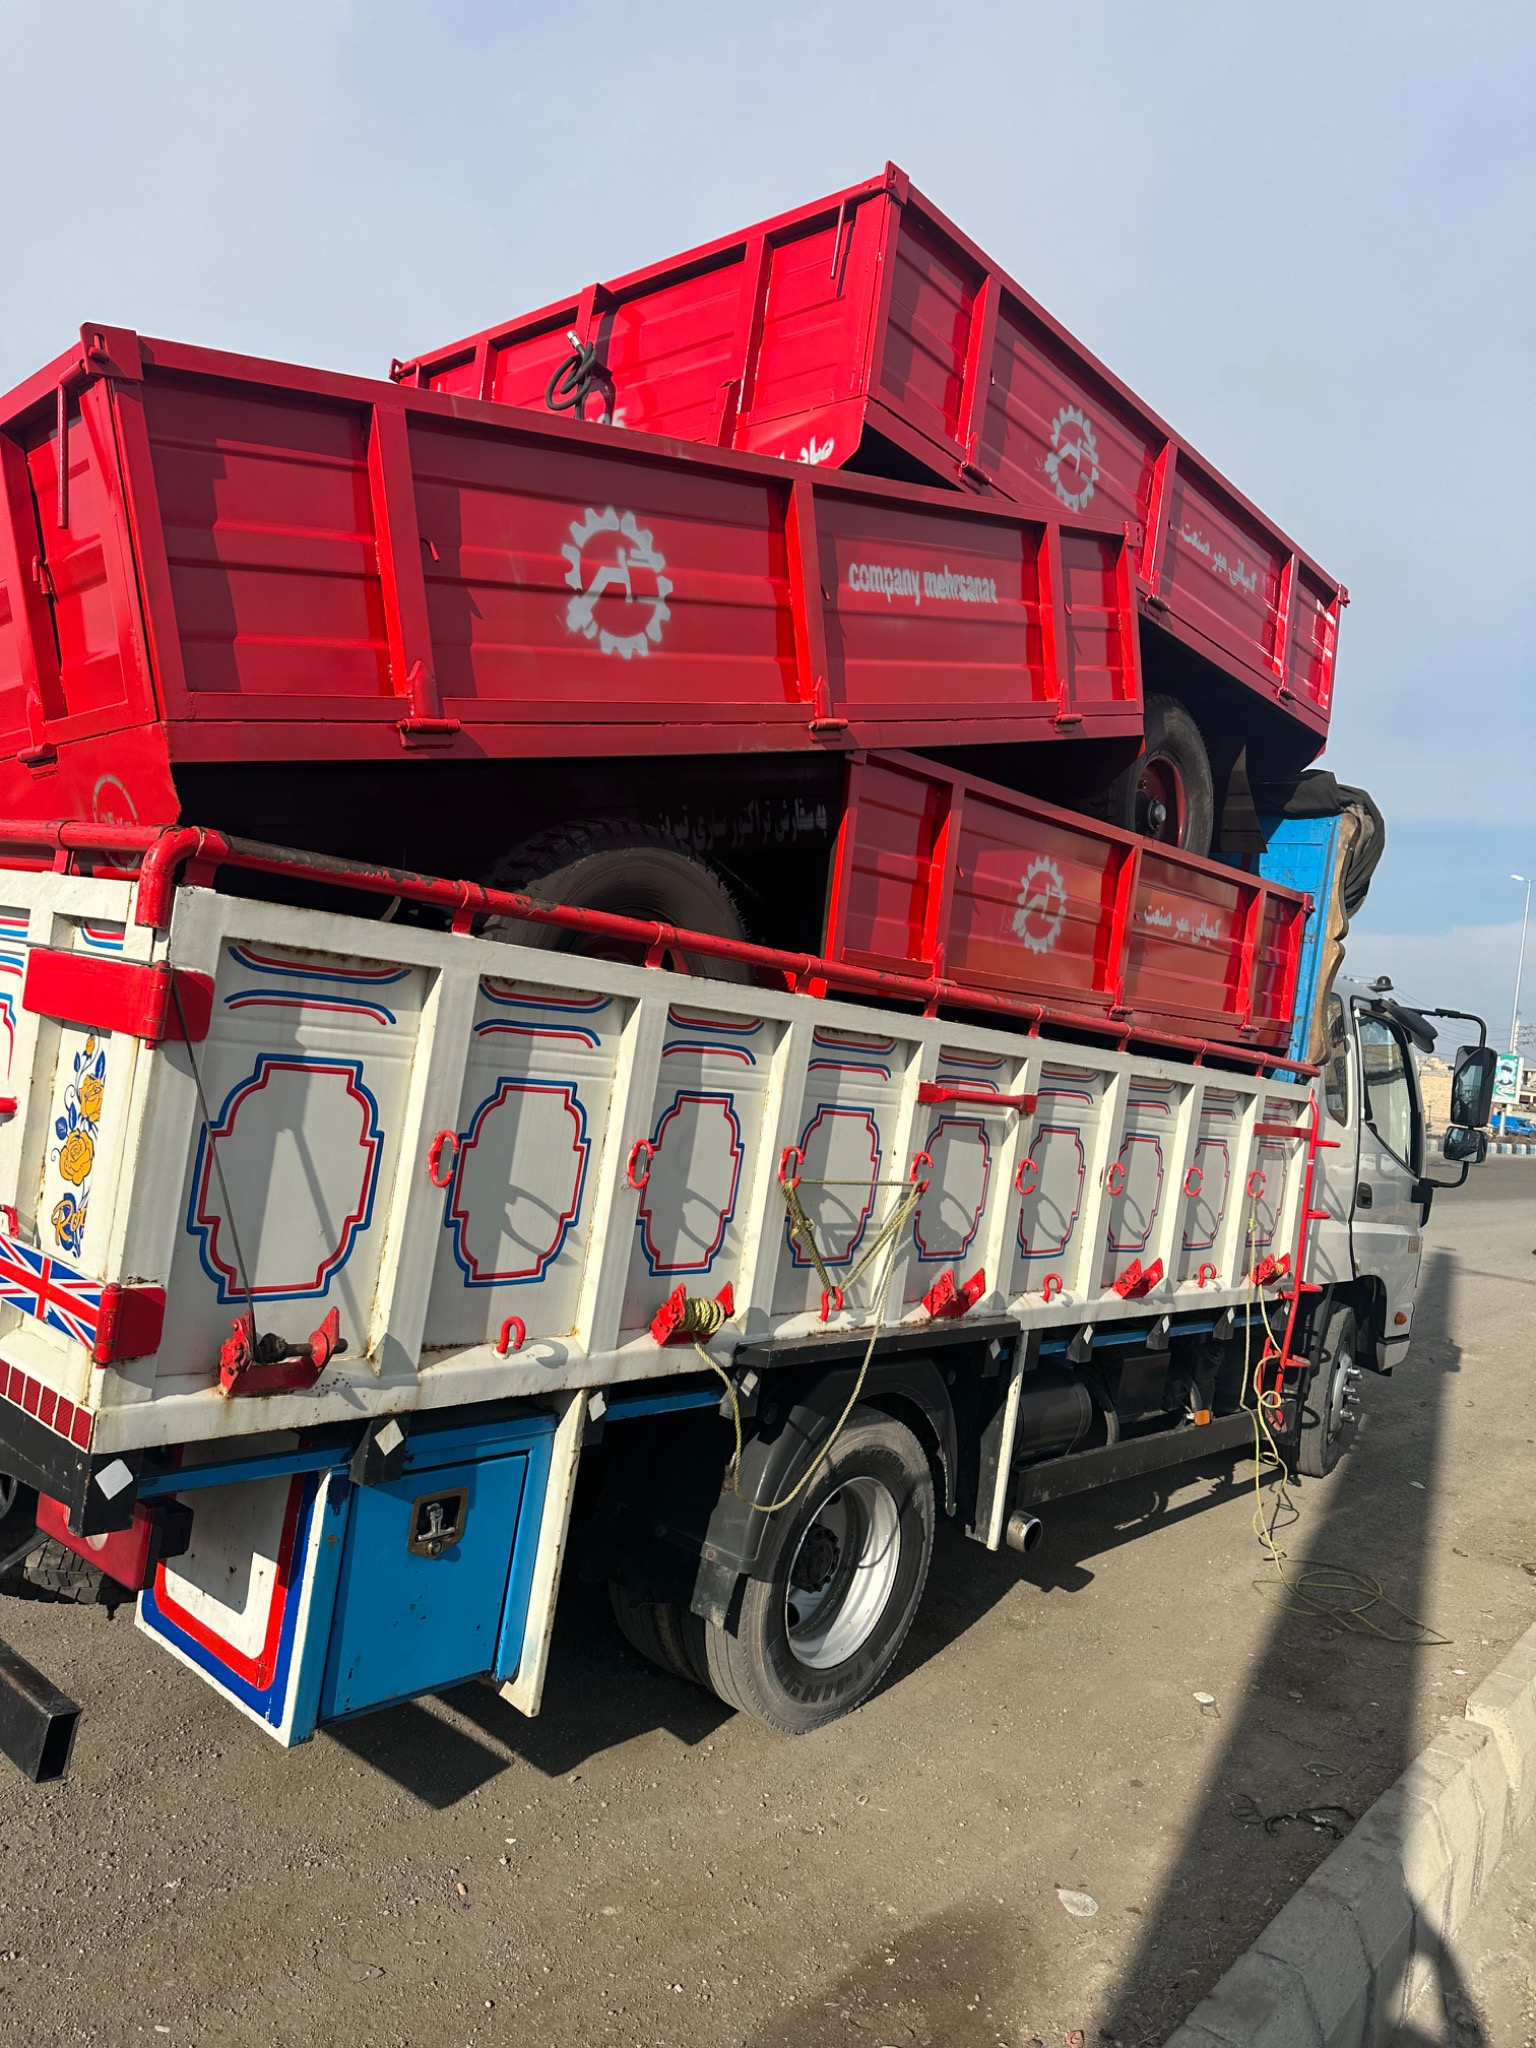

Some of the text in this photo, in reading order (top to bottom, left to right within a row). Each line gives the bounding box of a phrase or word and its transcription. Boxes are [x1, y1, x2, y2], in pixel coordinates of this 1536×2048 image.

[1179, 522, 1211, 557] صنعت
[848, 562, 999, 607] company mehrsanat
[1143, 903, 1173, 928] صنعت
